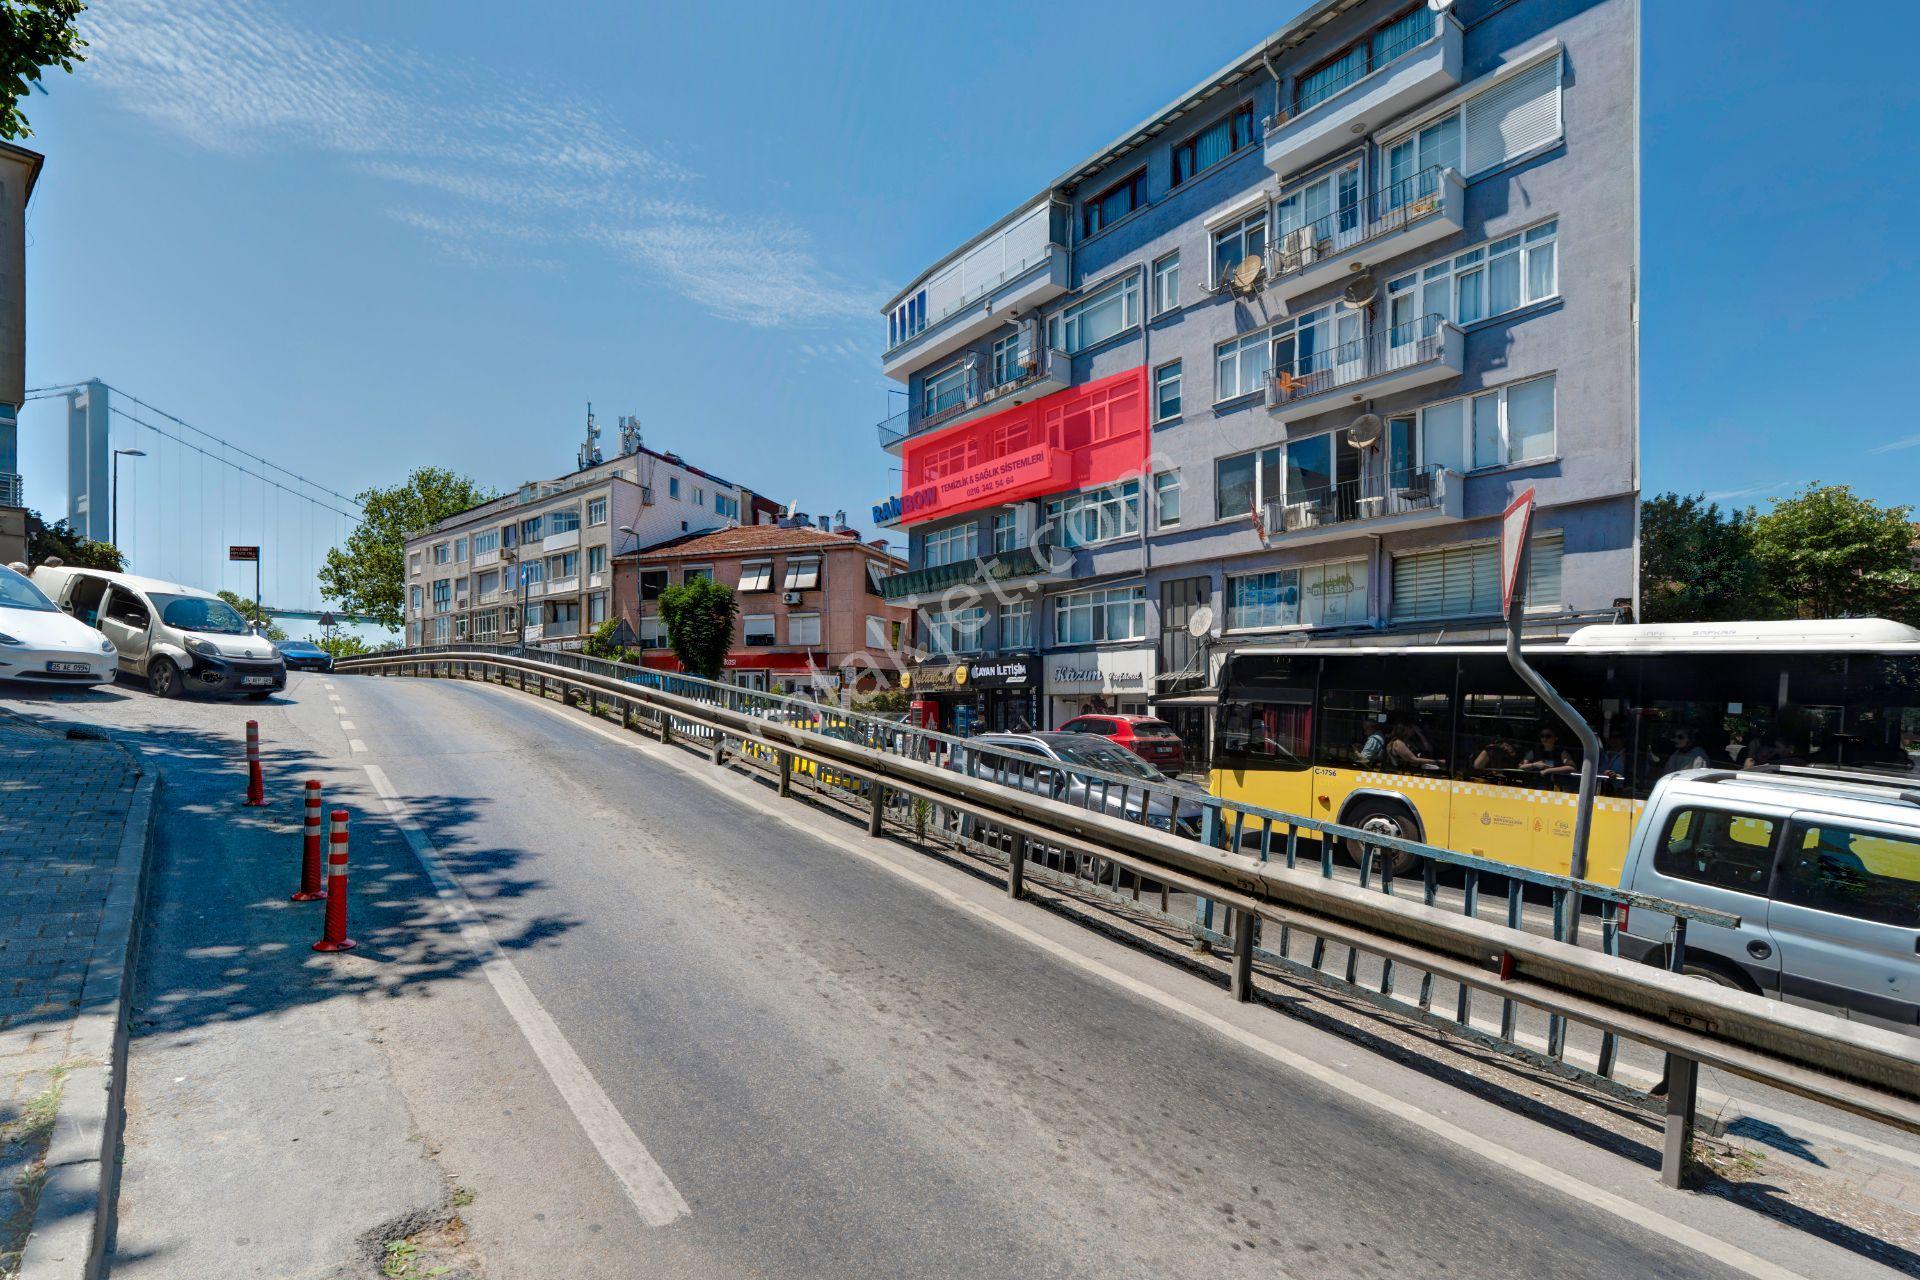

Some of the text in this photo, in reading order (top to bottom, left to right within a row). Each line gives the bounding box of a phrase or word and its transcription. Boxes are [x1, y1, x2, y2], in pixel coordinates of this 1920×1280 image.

[941, 450, 1044, 493] TEMİZLİK & SAĞLIK SİSTEMLERİ
[967, 487, 980, 496] 0216
[997, 663, 1026, 676] İLETİŞİM
[1315, 768, 1337, 777] C-1756
